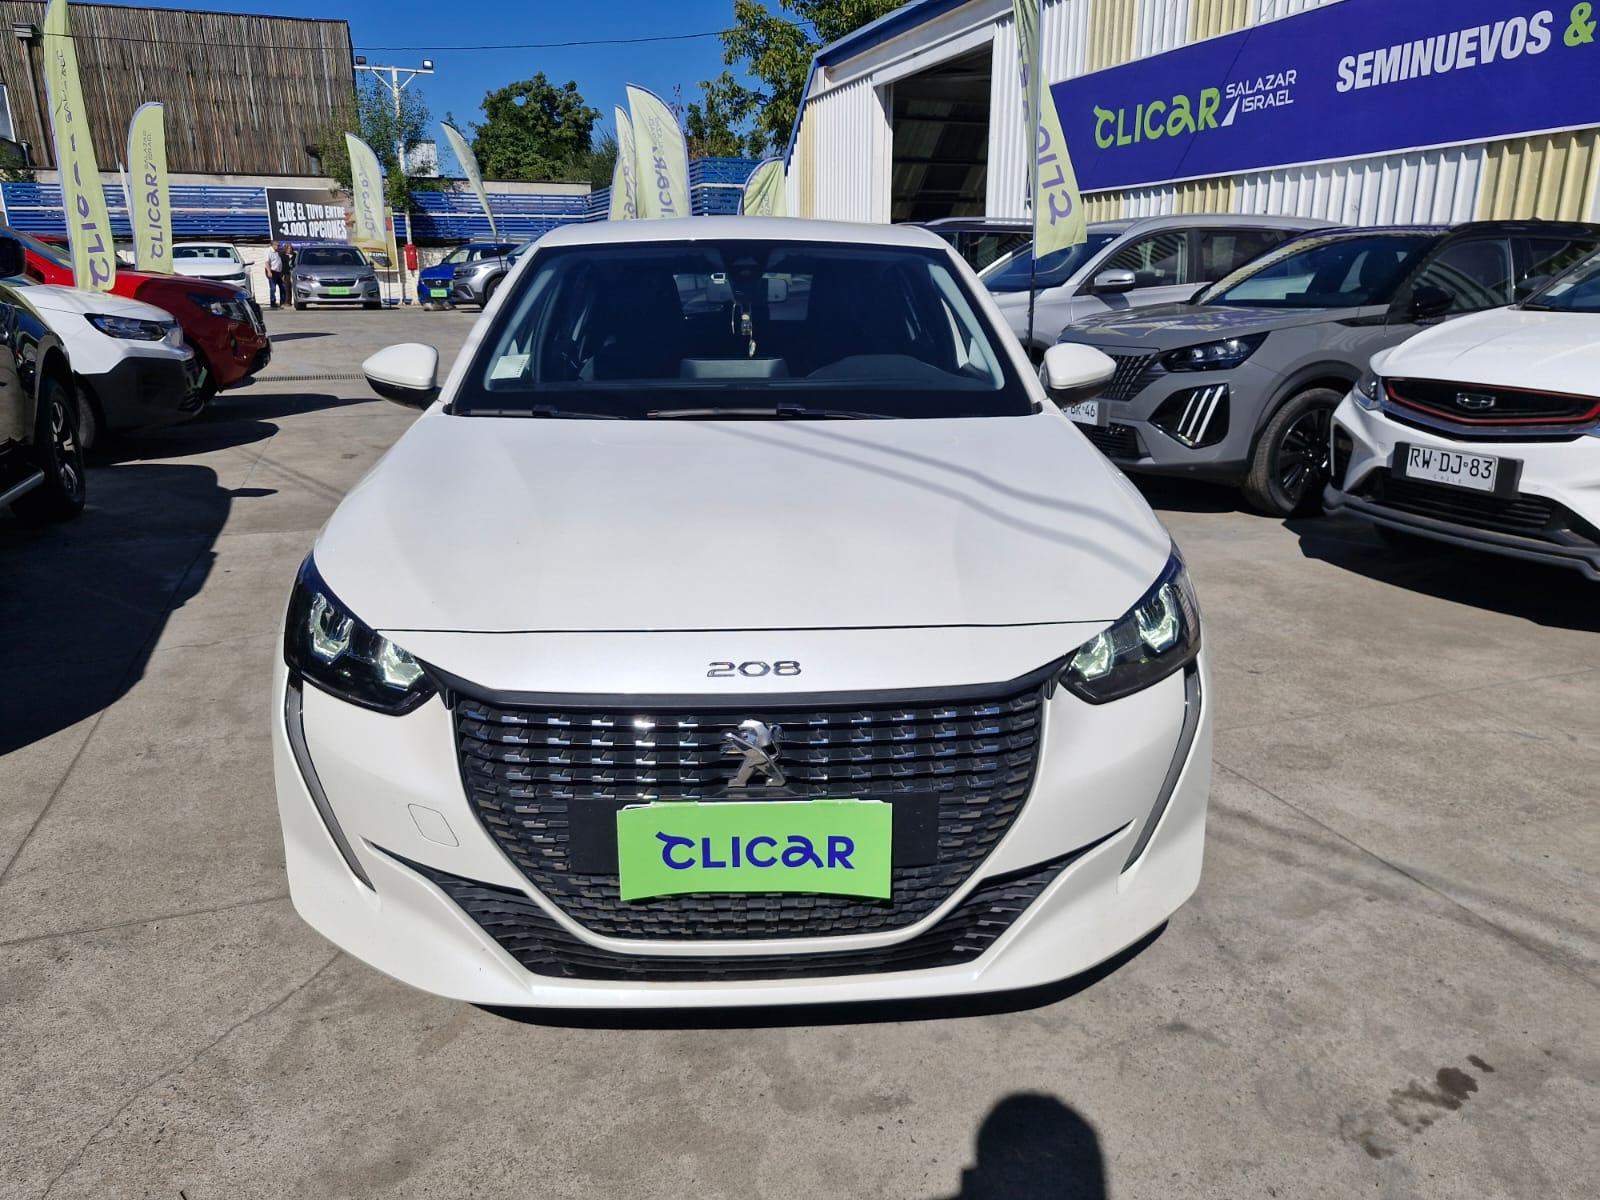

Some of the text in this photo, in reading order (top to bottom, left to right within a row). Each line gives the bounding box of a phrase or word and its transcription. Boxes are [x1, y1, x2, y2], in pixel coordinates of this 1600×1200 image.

[1336, 1, 1597, 93] SEMINUEVOS &
[1225, 69, 1297, 99] SALAZAR
[1241, 89, 1294, 113] ISRAEL
[276, 201, 345, 222] ELIGE EL TUYO ENTRE
[308, 219, 347, 239] OPCIONES
[706, 660, 802, 677] 208
